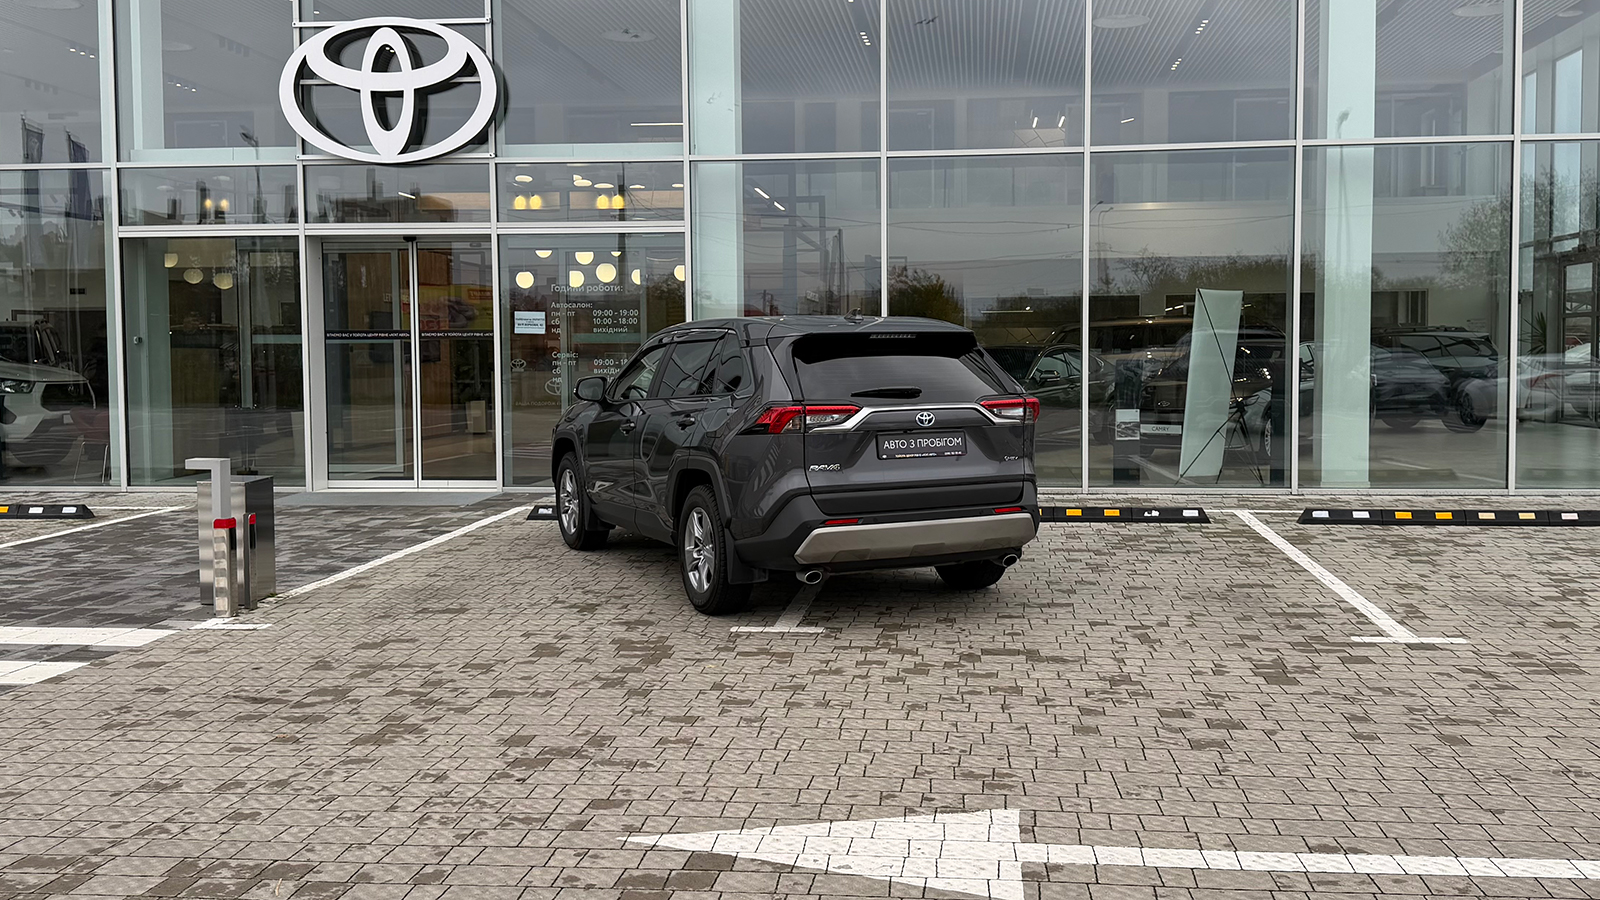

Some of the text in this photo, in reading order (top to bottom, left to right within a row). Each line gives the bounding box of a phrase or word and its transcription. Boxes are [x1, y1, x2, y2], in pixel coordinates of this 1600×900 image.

[551, 283, 623, 293] Години роботи:
[593, 326, 628, 334] вихідний
[552, 351, 579, 359] Сервіс:
[593, 358, 614, 366] 09:00
[593, 366, 620, 374] вихідн
[883, 439, 908, 449] АВТО
[917, 437, 962, 448] ПРОБІГОМ
[809, 463, 841, 472] RAV4
